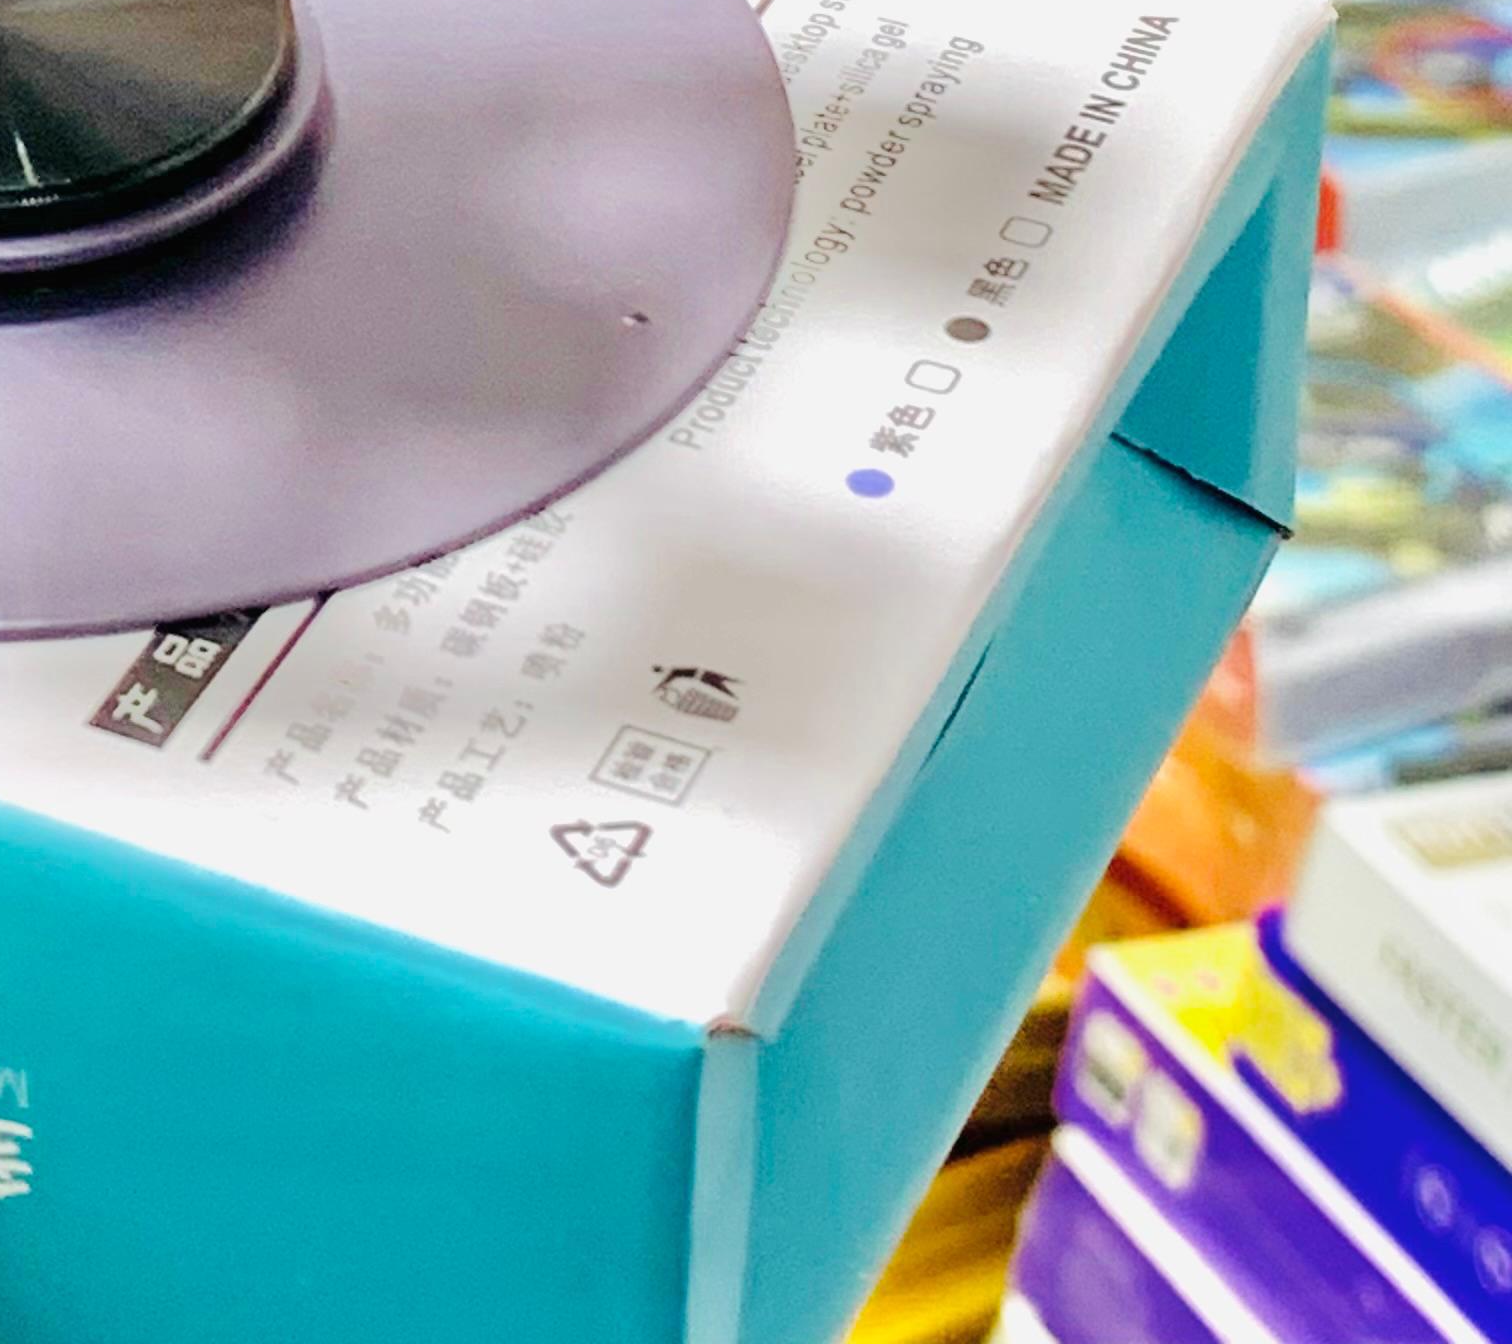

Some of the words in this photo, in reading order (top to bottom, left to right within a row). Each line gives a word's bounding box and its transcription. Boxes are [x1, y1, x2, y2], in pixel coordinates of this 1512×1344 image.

[782, 12, 840, 82] esktop
[872, 17, 910, 49] gel
[1101, 14, 1179, 92] CHINA
[1079, 94, 1128, 126] IN
[1030, 124, 1107, 205] MADE
[669, 350, 763, 450] Product
[840, 130, 910, 215] powder
[899, 34, 985, 128] spraying
[967, 256, 1030, 308] 黑色
[869, 404, 935, 458] 紫色
